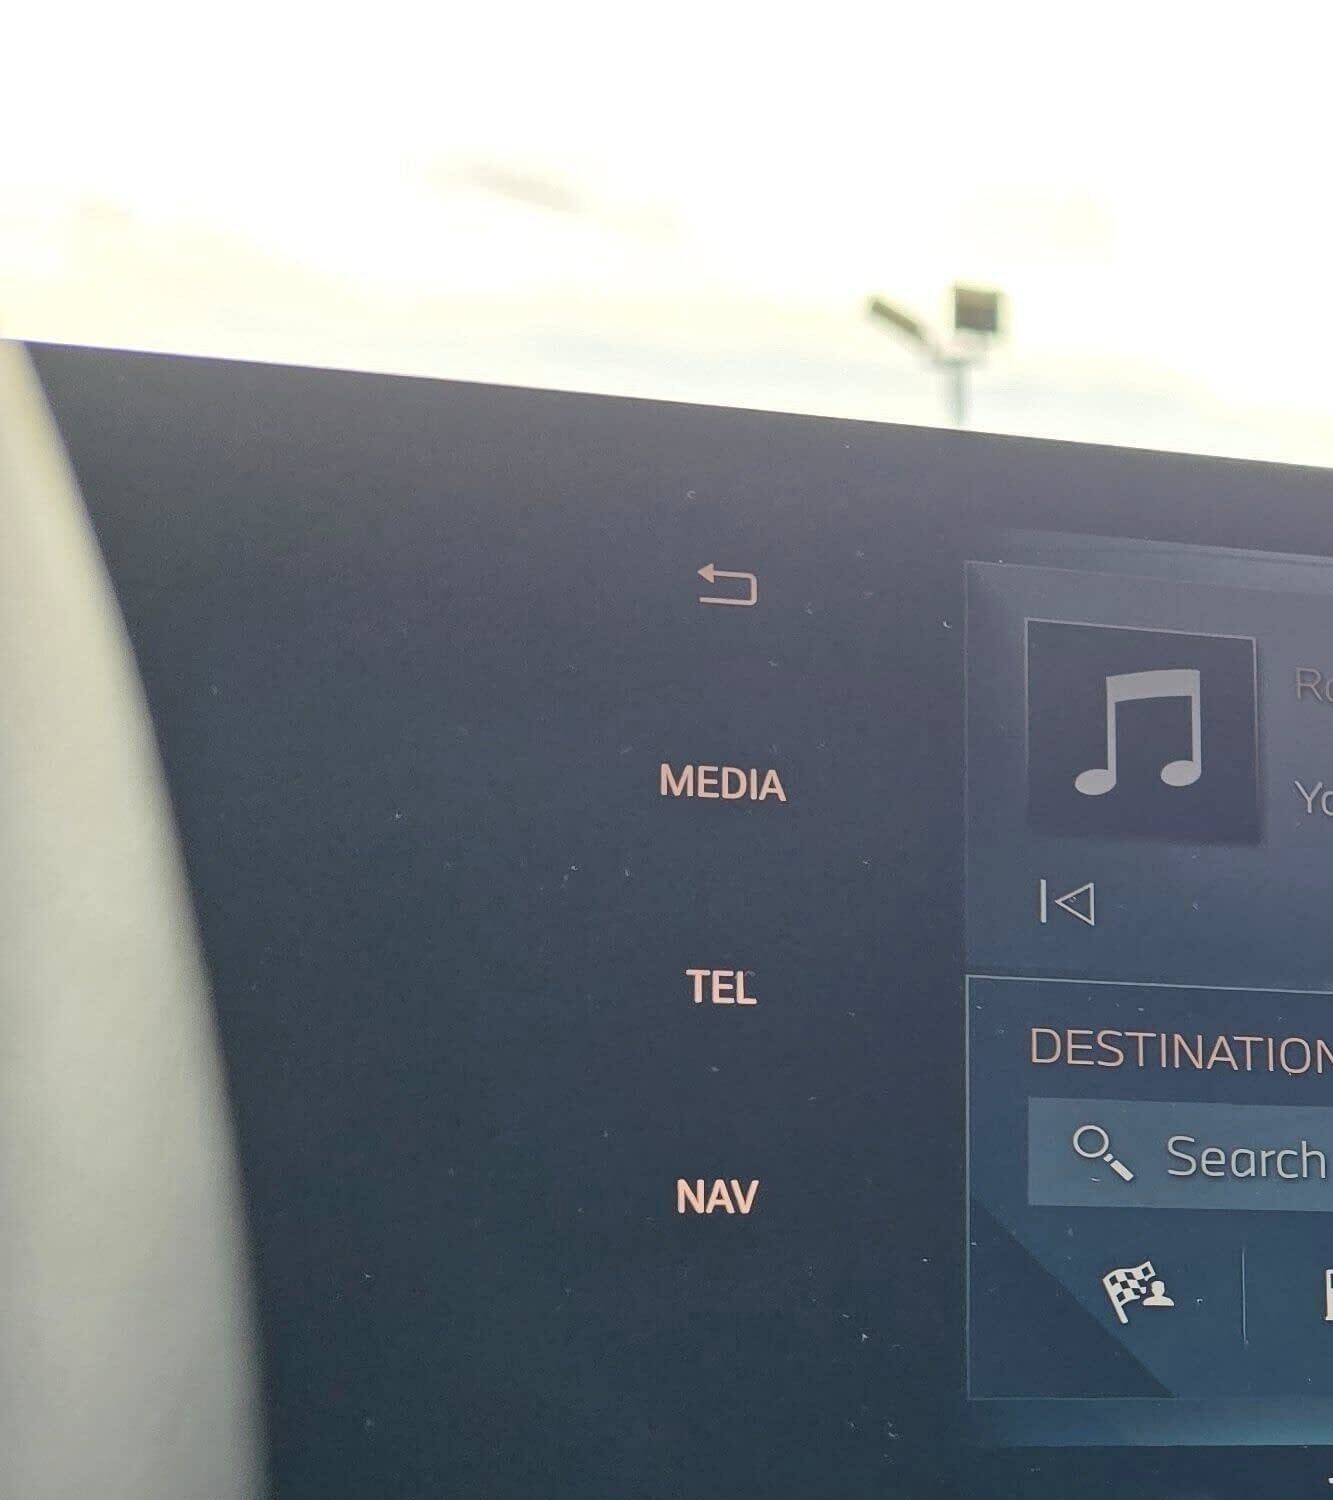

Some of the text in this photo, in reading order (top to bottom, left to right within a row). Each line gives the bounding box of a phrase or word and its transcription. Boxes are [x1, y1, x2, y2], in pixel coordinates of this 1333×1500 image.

[658, 762, 787, 802] MEDIA
[685, 968, 758, 1005] TEL
[1167, 1135, 1327, 1179] Search
[676, 1178, 759, 1214] NAV
